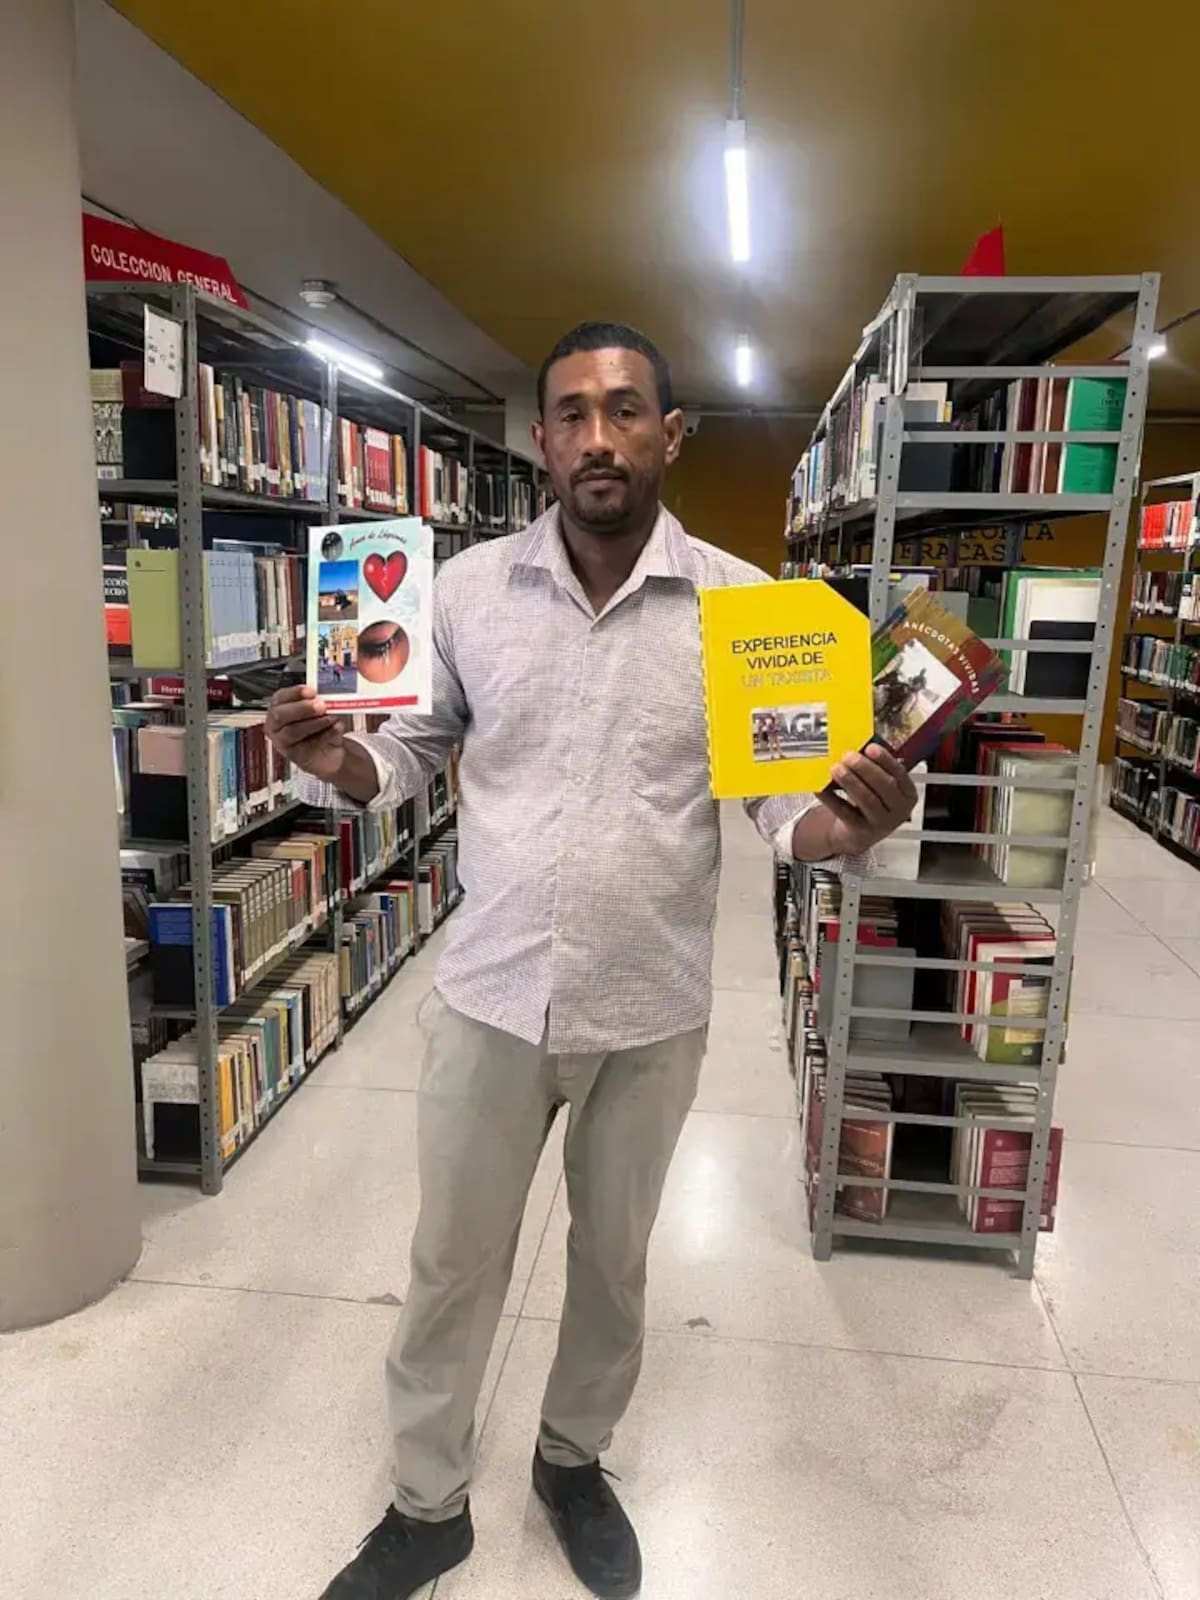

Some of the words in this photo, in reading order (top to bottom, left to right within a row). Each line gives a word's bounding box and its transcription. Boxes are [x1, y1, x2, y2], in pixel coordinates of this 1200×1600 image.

[90, 244, 172, 283] COLECCION
[177, 269, 238, 303] GENERAL
[731, 631, 838, 655] EXPERIENCIA
[746, 653, 799, 670] VIVIDA
[802, 651, 824, 666] DE
[958, 653, 980, 694] VIVIDAS
